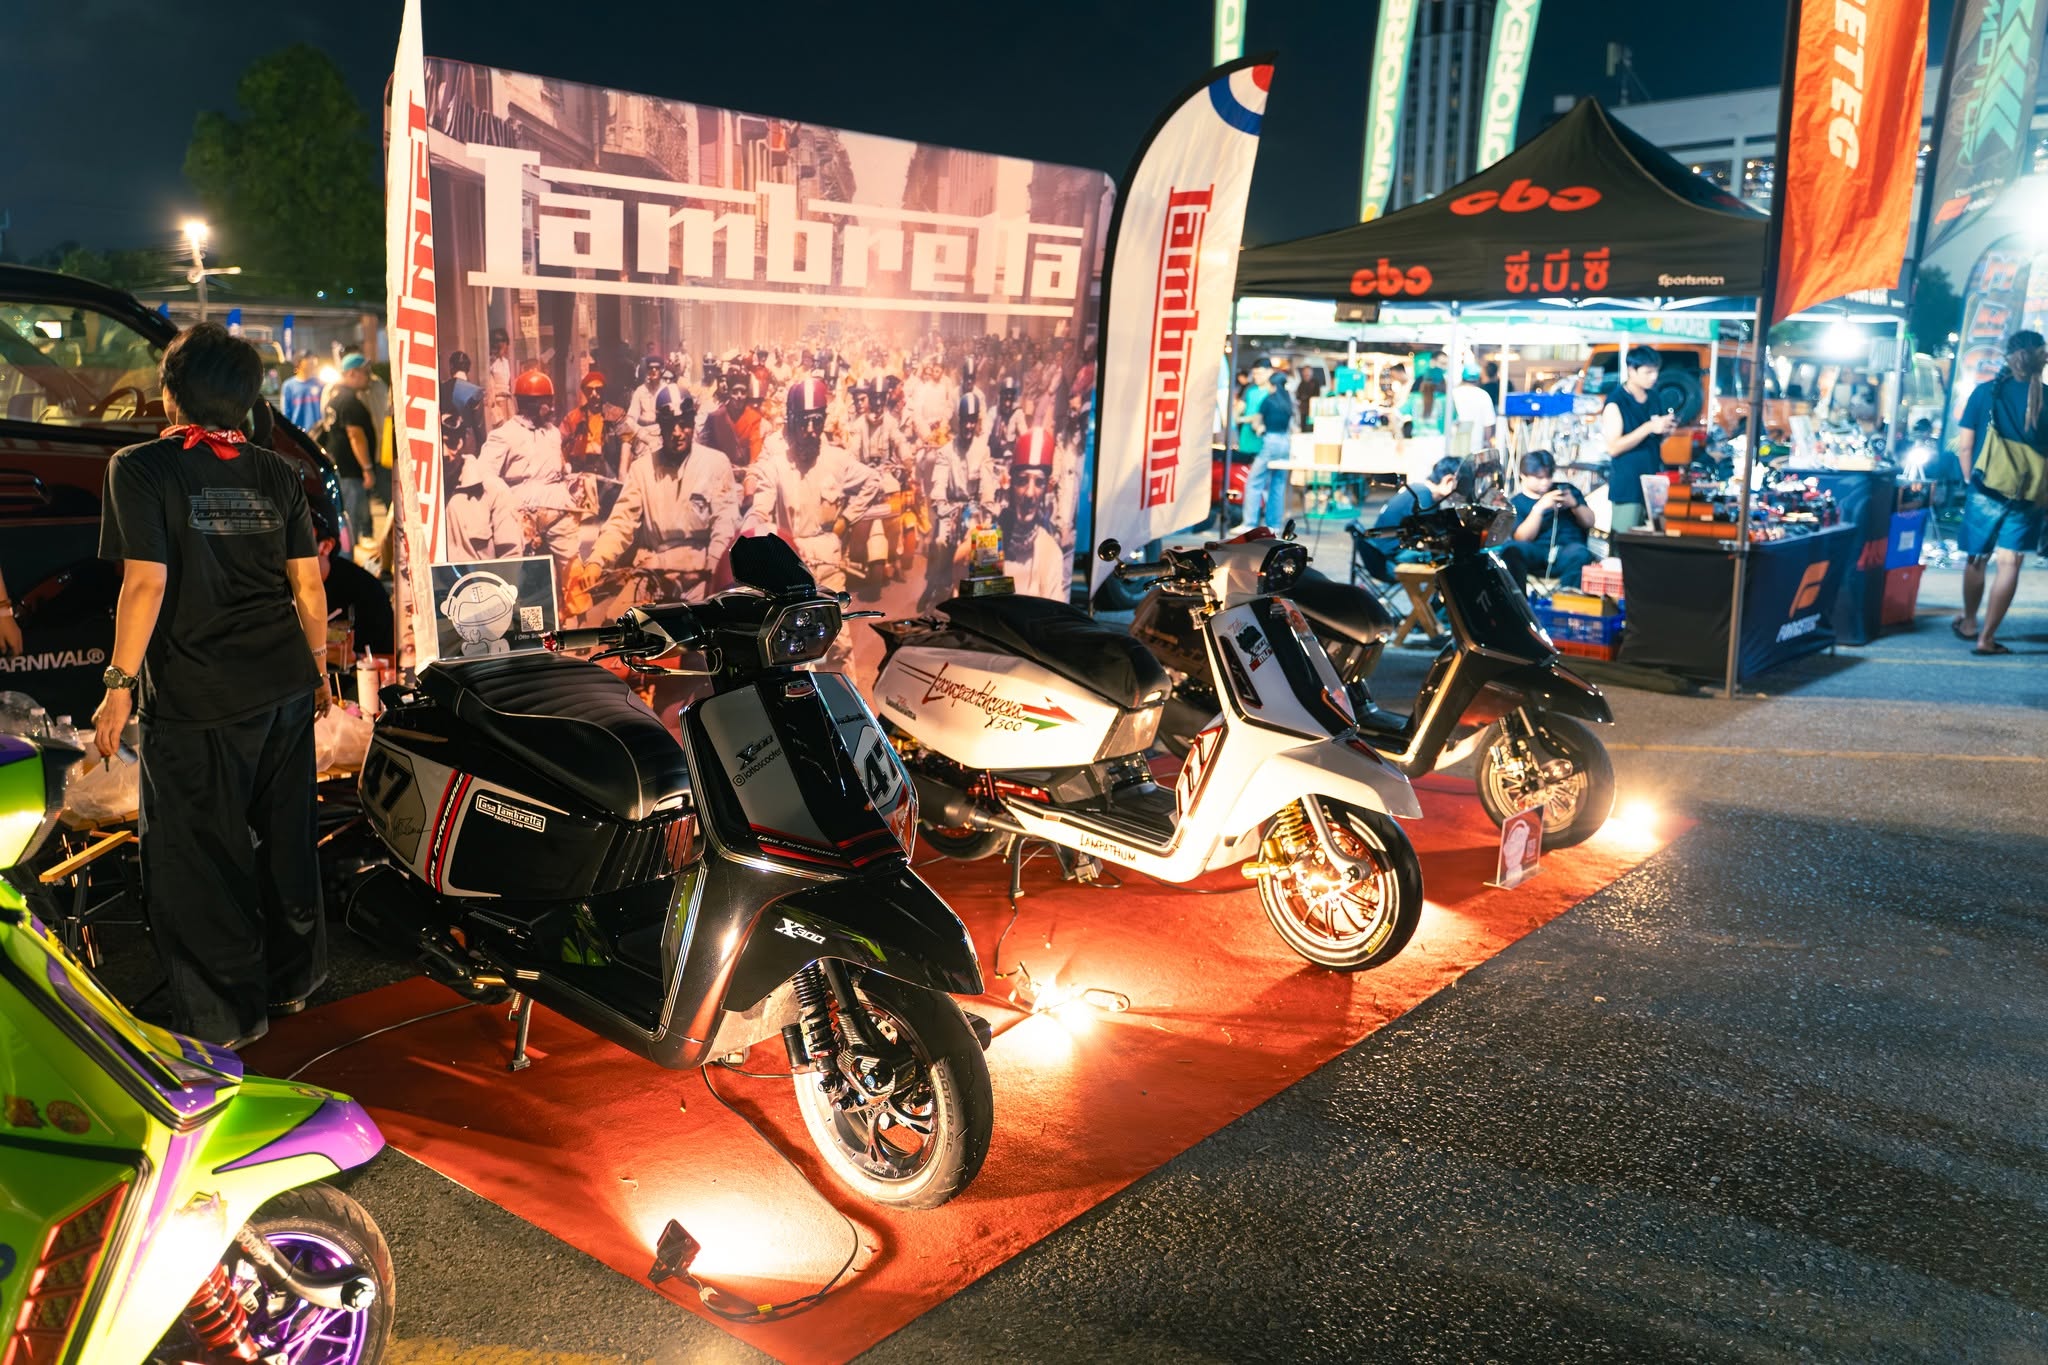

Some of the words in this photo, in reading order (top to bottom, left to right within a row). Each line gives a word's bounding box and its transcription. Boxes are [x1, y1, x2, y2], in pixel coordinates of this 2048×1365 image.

[465, 143, 1084, 317] Lambretta
[1657, 273, 1725, 288] Sportsman
[1140, 183, 1214, 511] Lambretta
[984, 714, 1023, 733] X300
[479, 797, 497, 815] Casa
[496, 804, 543, 829] Lambretta
[494, 814, 511, 825] RACING
[511, 820, 524, 828] TEAM
[774, 917, 827, 945] X300
